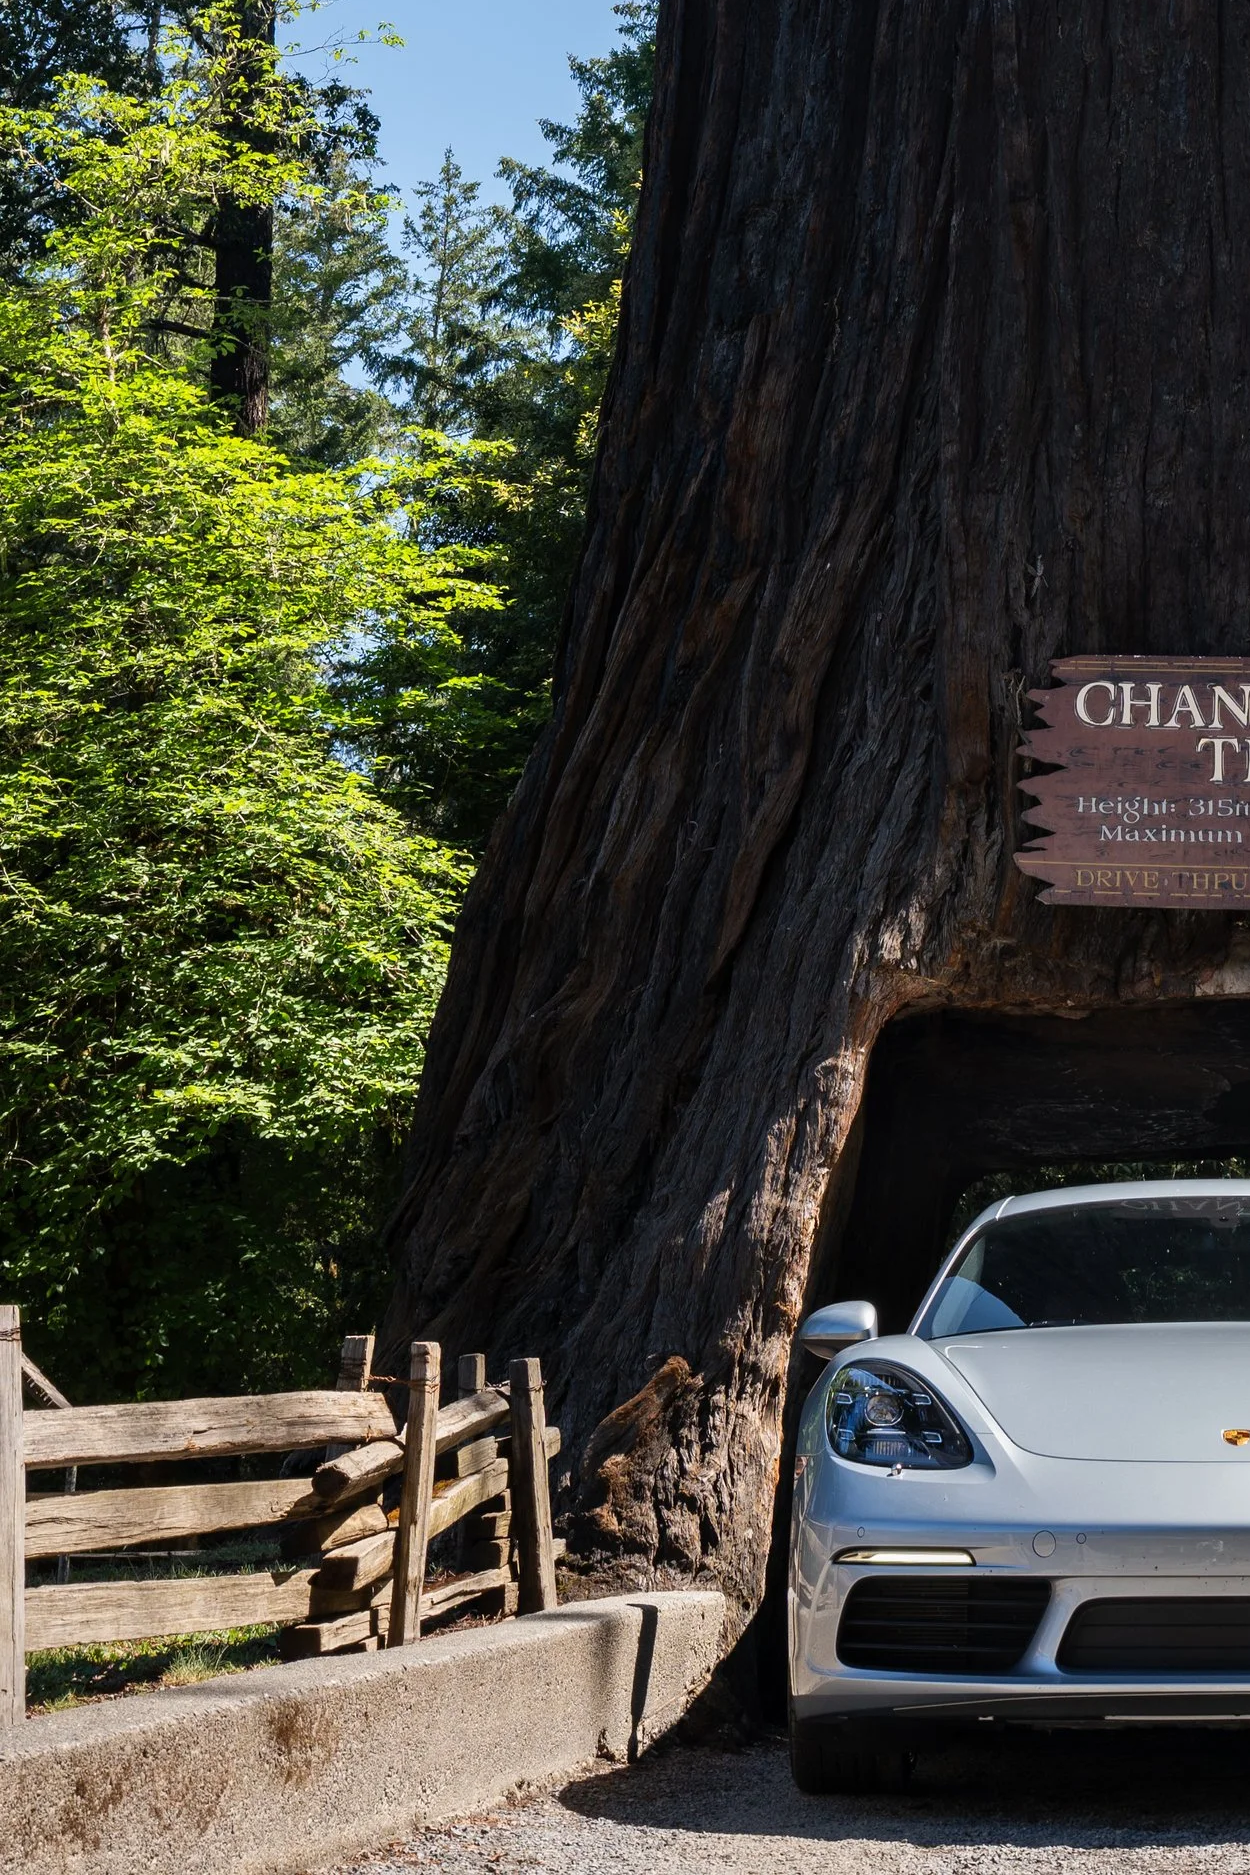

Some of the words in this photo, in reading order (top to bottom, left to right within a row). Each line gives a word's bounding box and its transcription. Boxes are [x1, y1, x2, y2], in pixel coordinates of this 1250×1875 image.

[1077, 796, 1176, 823] Height:
[1188, 798, 1250, 817] 315ft
[1099, 825, 1243, 844] Maximum
[1076, 869, 1160, 888] DRIVE
